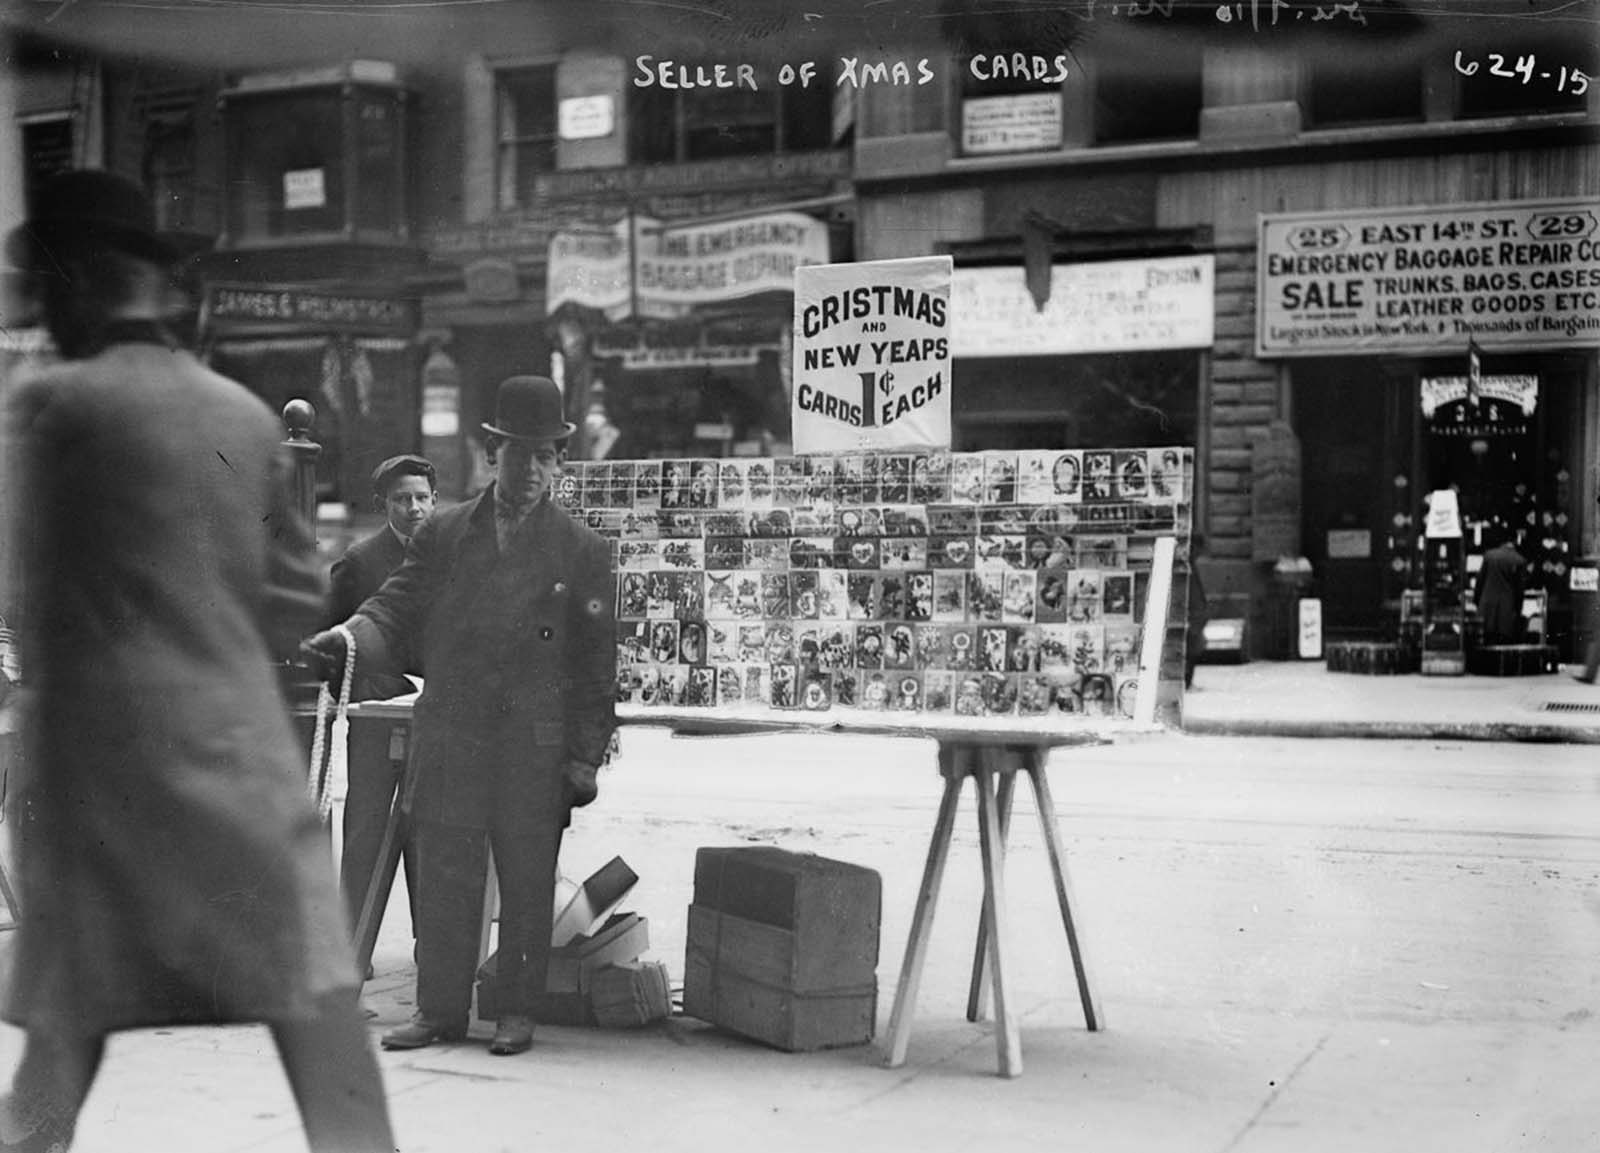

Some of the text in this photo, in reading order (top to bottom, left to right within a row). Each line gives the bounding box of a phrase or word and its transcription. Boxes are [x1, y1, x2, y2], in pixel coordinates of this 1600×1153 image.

[1299, 227, 1340, 248] 25
[1361, 224, 1427, 245] EAST
[1480, 218, 1519, 239] ST.
[1540, 215, 1585, 237] 29
[1268, 251, 1389, 277] EMERGENCY
[1395, 246, 1494, 271] BAGGAGE
[1500, 241, 1573, 266] REPAIR
[1281, 279, 1364, 310] SALE
[1376, 297, 1464, 319] LEATHER
[1471, 293, 1546, 314] GOODS
[803, 286, 946, 338] CRISTMAS
[862, 321, 887, 333] AND
[1525, 315, 1542, 332] of
[804, 343, 861, 371] NEW
[798, 384, 862, 428] CARDS
[882, 371, 941, 426] EACH
